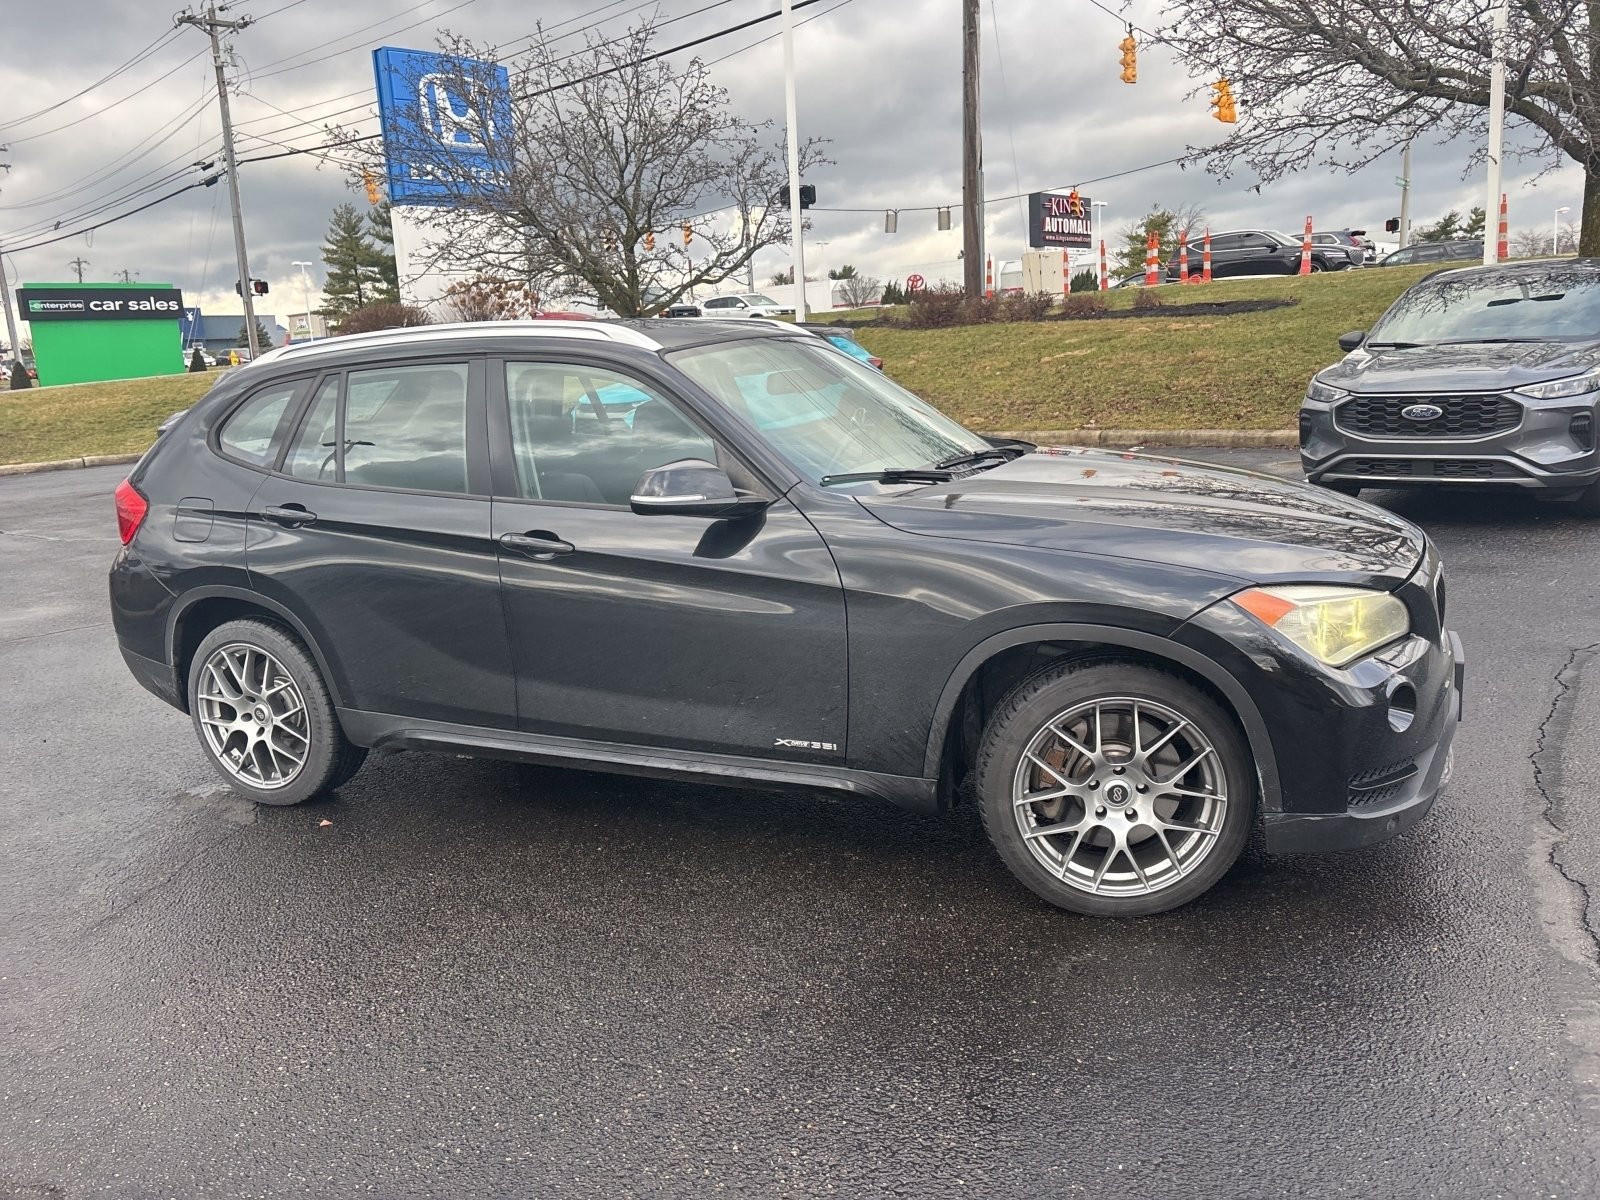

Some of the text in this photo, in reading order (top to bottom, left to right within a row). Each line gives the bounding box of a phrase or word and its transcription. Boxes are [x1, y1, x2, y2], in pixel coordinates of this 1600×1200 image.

[1051, 197, 1085, 218] KINS
[1045, 217, 1091, 234] AUTOMALL
[1045, 234, 1091, 243] www.kingsautomall.com
[33, 296, 179, 311] enterprise car sales
[1410, 407, 1433, 417] Ford
